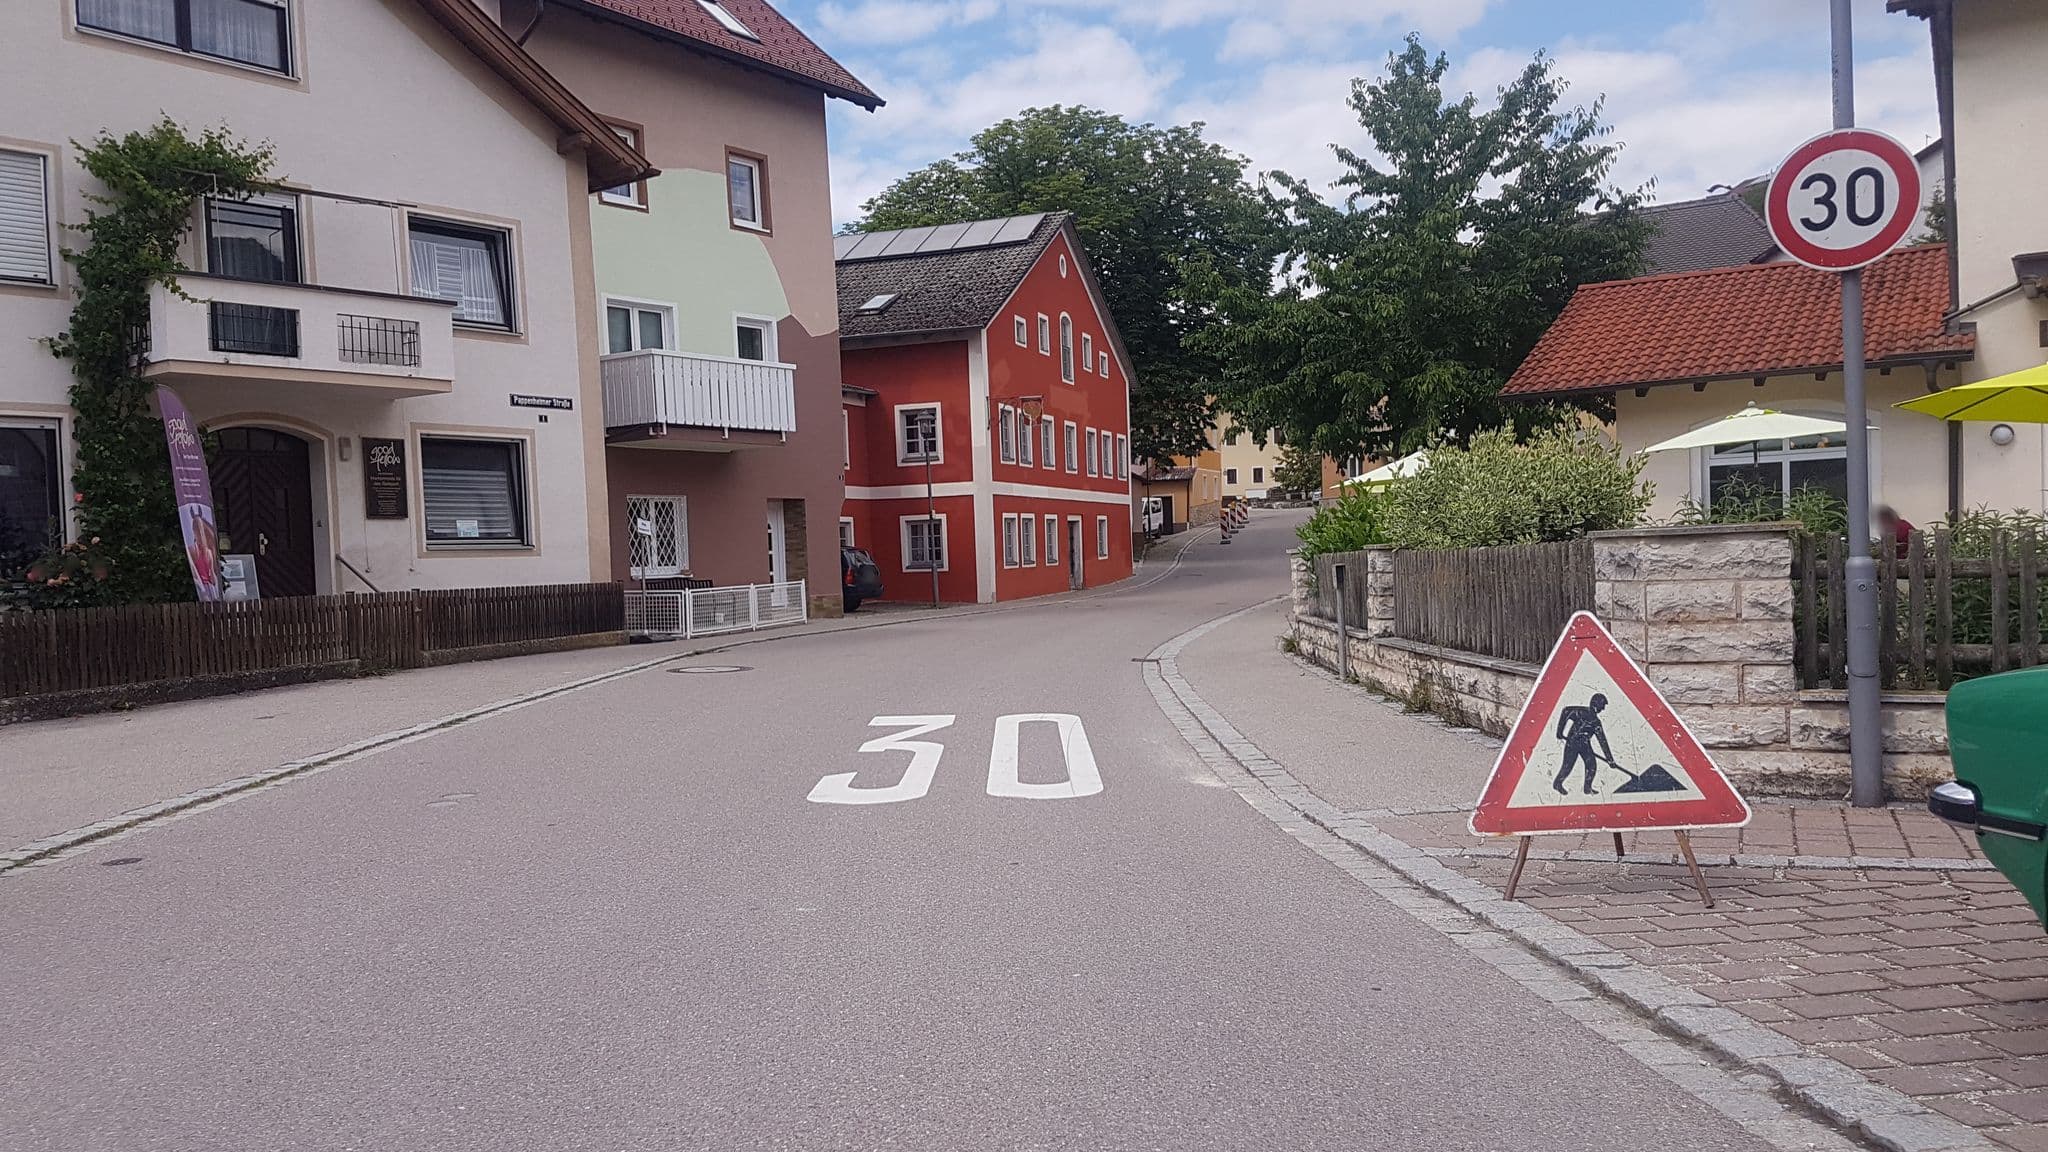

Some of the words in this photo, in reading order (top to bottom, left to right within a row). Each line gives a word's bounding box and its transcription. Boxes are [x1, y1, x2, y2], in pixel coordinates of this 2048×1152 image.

[1800, 167, 1884, 231] 30
[513, 395, 551, 406] Pappenheimer
[553, 398, 571, 408] Straße
[370, 442, 395, 460] good
[806, 714, 1104, 804] 30
